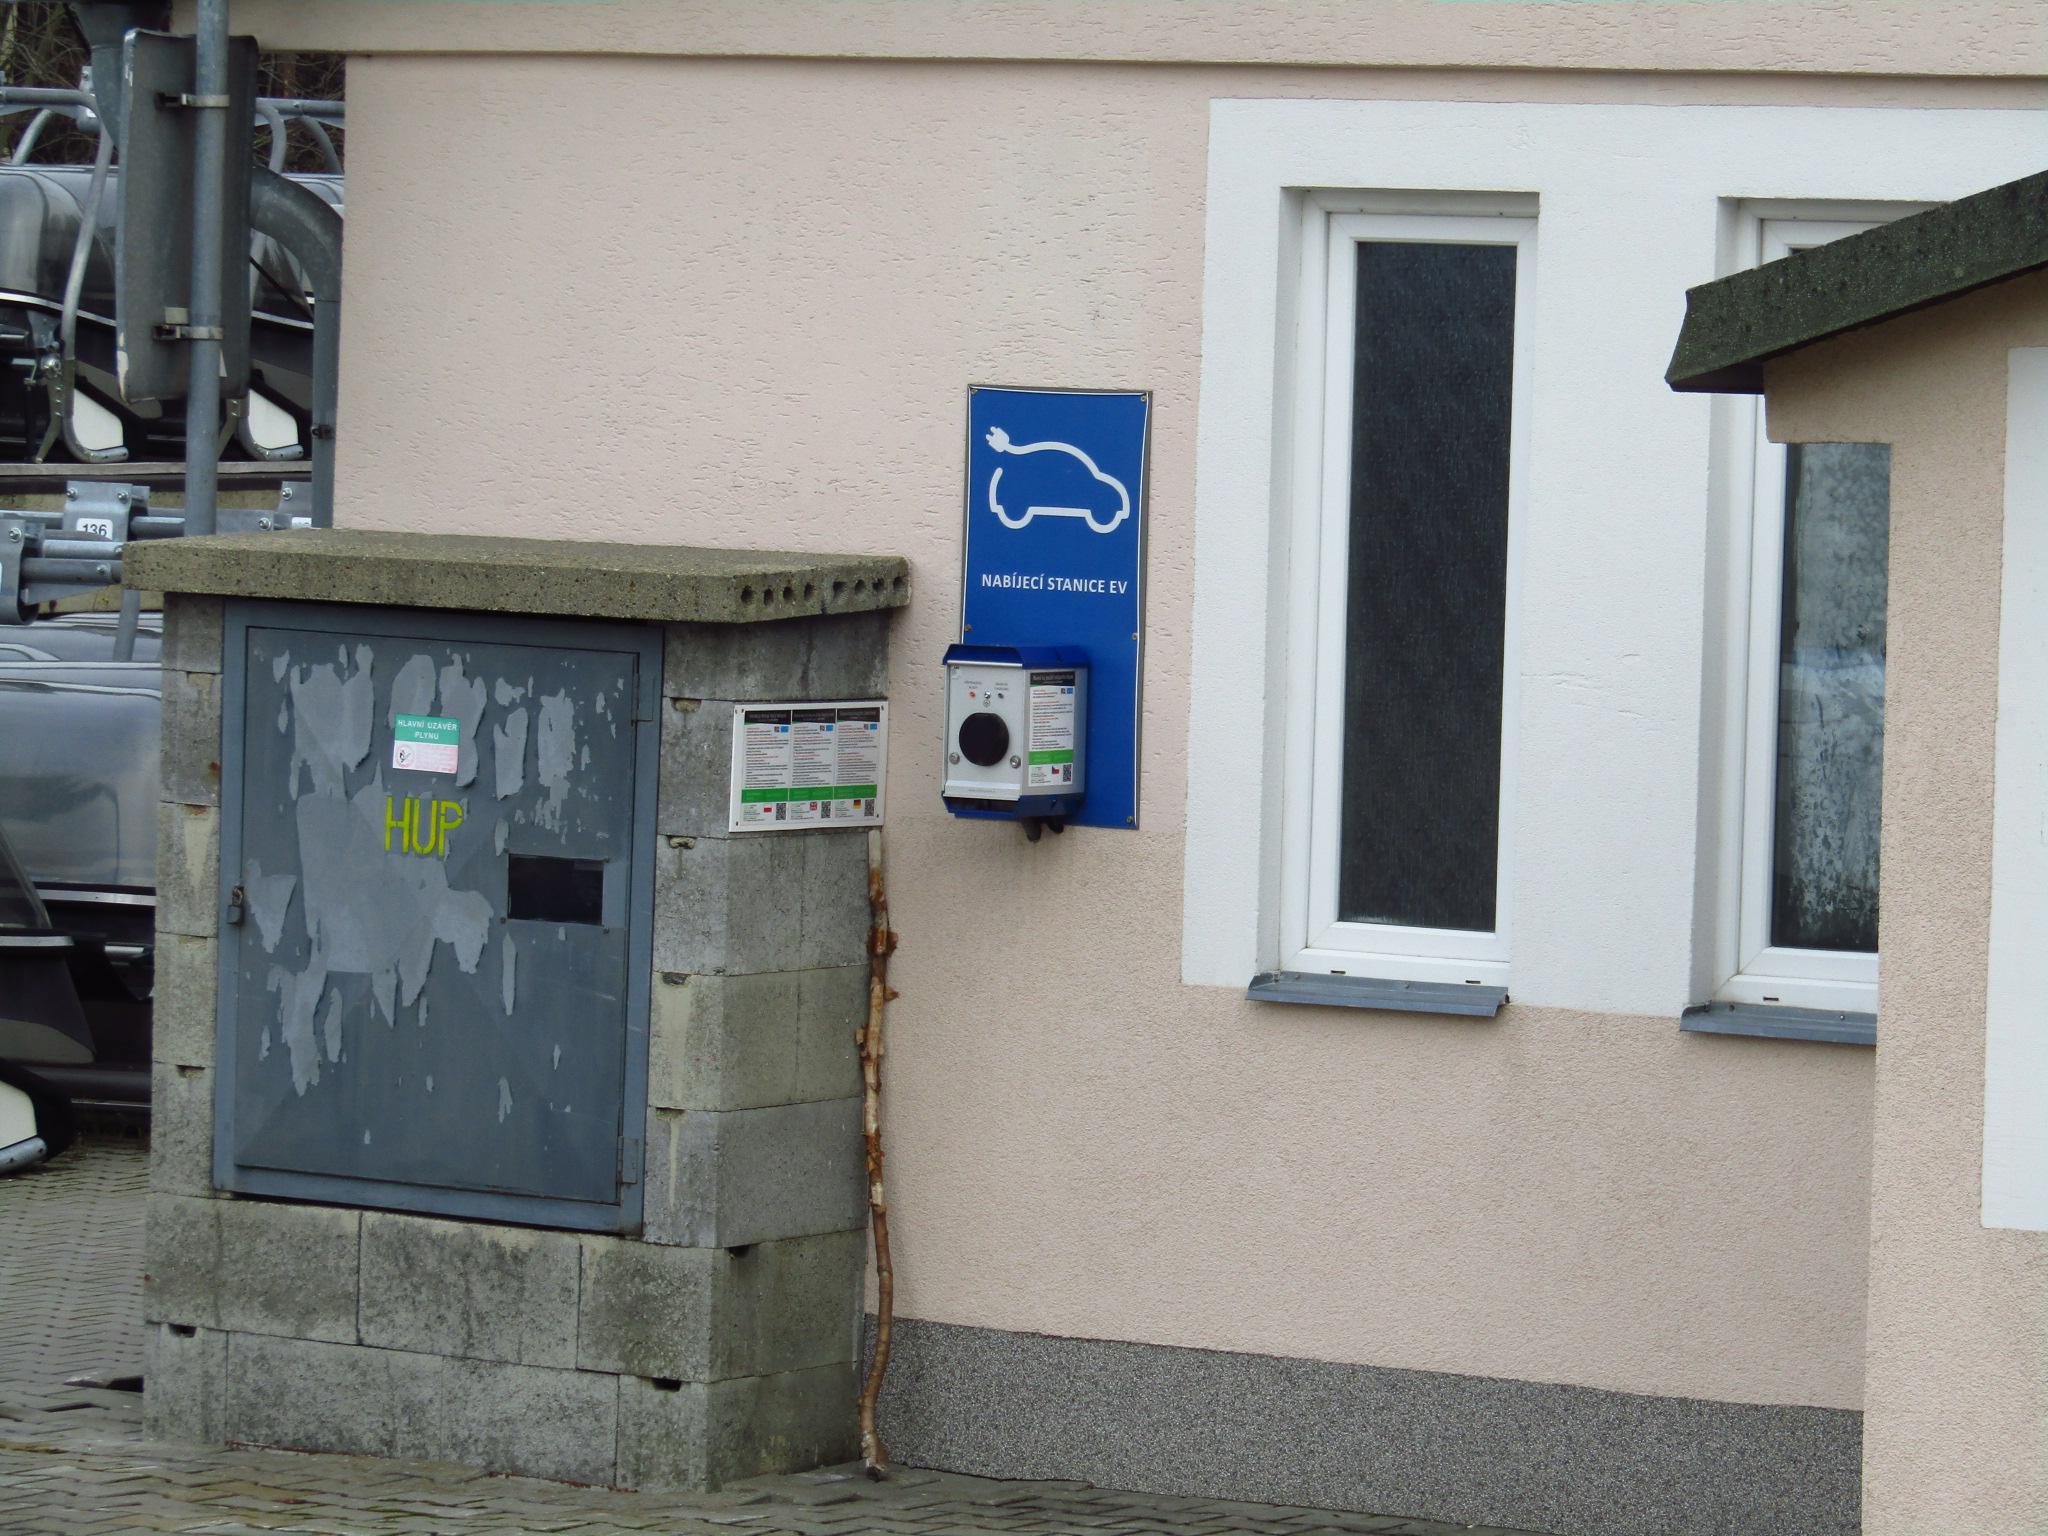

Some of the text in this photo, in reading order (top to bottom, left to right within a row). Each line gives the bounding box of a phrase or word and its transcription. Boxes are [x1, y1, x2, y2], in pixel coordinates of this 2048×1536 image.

[82, 523, 107, 537] 136
[982, 571, 1128, 594] NABÍJECÍ STANICE EV
[415, 731, 439, 740] PLYNU
[385, 795, 463, 857] HUP
